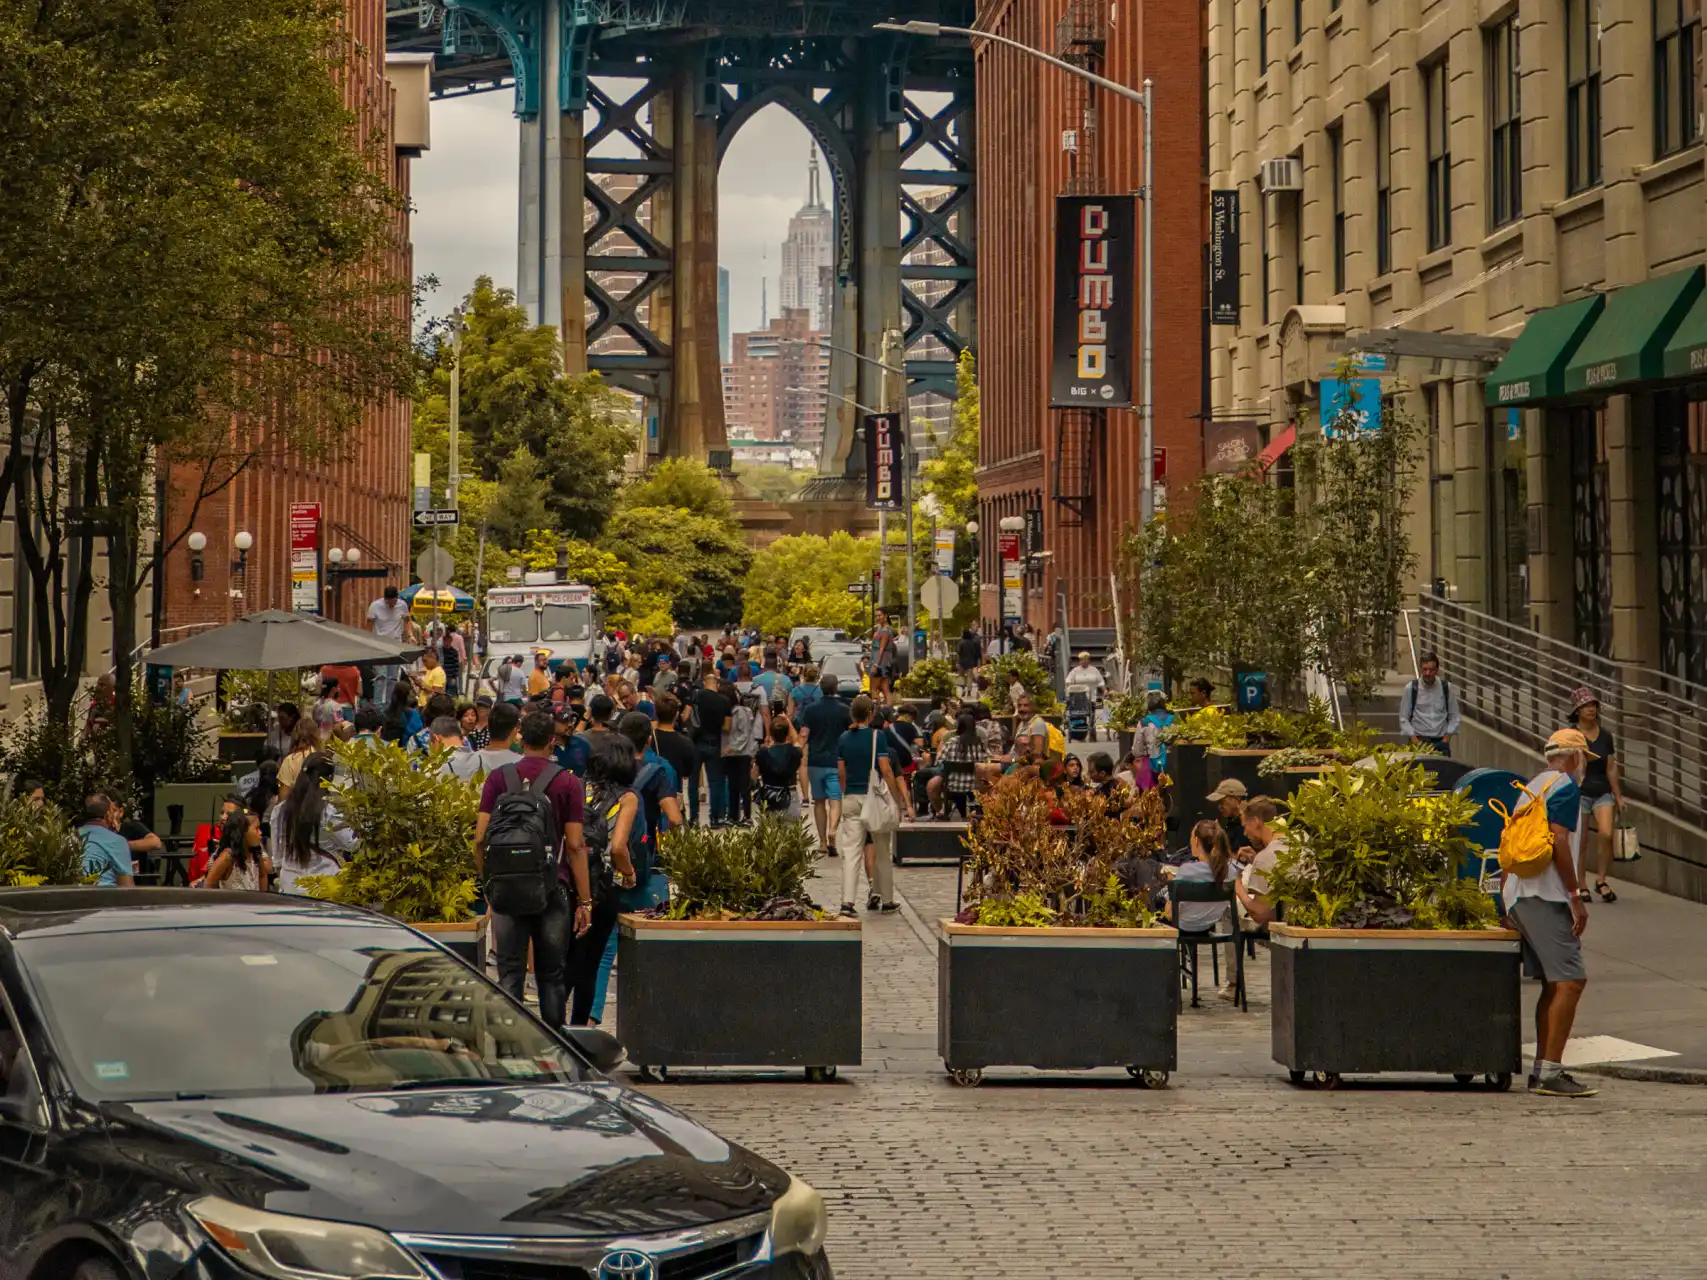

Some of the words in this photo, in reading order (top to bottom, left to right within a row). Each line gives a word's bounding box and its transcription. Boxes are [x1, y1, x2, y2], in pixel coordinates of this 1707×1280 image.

[1215, 196, 1225, 207] 55
[1213, 210, 1225, 266] Washington
[1214, 268, 1226, 282] St.
[1078, 205, 1113, 378] DUMBO
[1070, 386, 1087, 395] BIG
[876, 417, 893, 499] DUMBO
[495, 596, 504, 604] ICE
[552, 594, 561, 602] ICE
[562, 593, 582, 602] CREAM
[1247, 686, 1257, 703] P
